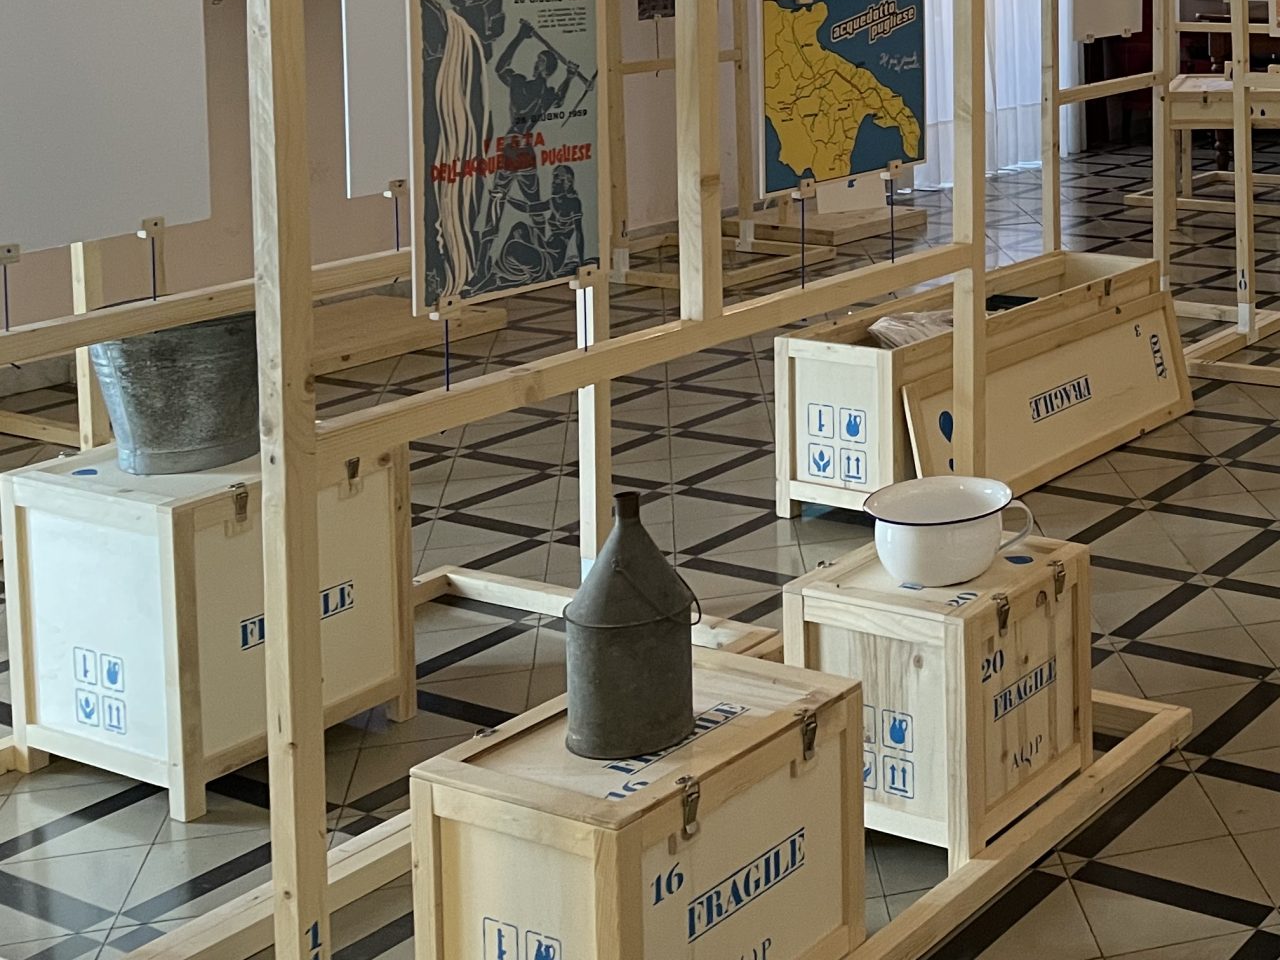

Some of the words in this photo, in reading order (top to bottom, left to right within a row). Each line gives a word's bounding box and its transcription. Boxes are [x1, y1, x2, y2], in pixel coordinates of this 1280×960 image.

[832, 0, 896, 39] acquedotto
[870, 7, 915, 40] pugliese
[541, 143, 592, 166] PUGLIESE
[1134, 324, 1142, 337] 3
[1029, 377, 1092, 420] FRAGILE
[982, 649, 1004, 684] 20
[994, 657, 1057, 720] FRAGILE
[1012, 734, 1043, 770] AQP
[651, 862, 684, 906] 16
[688, 832, 805, 940] FRAGILE
